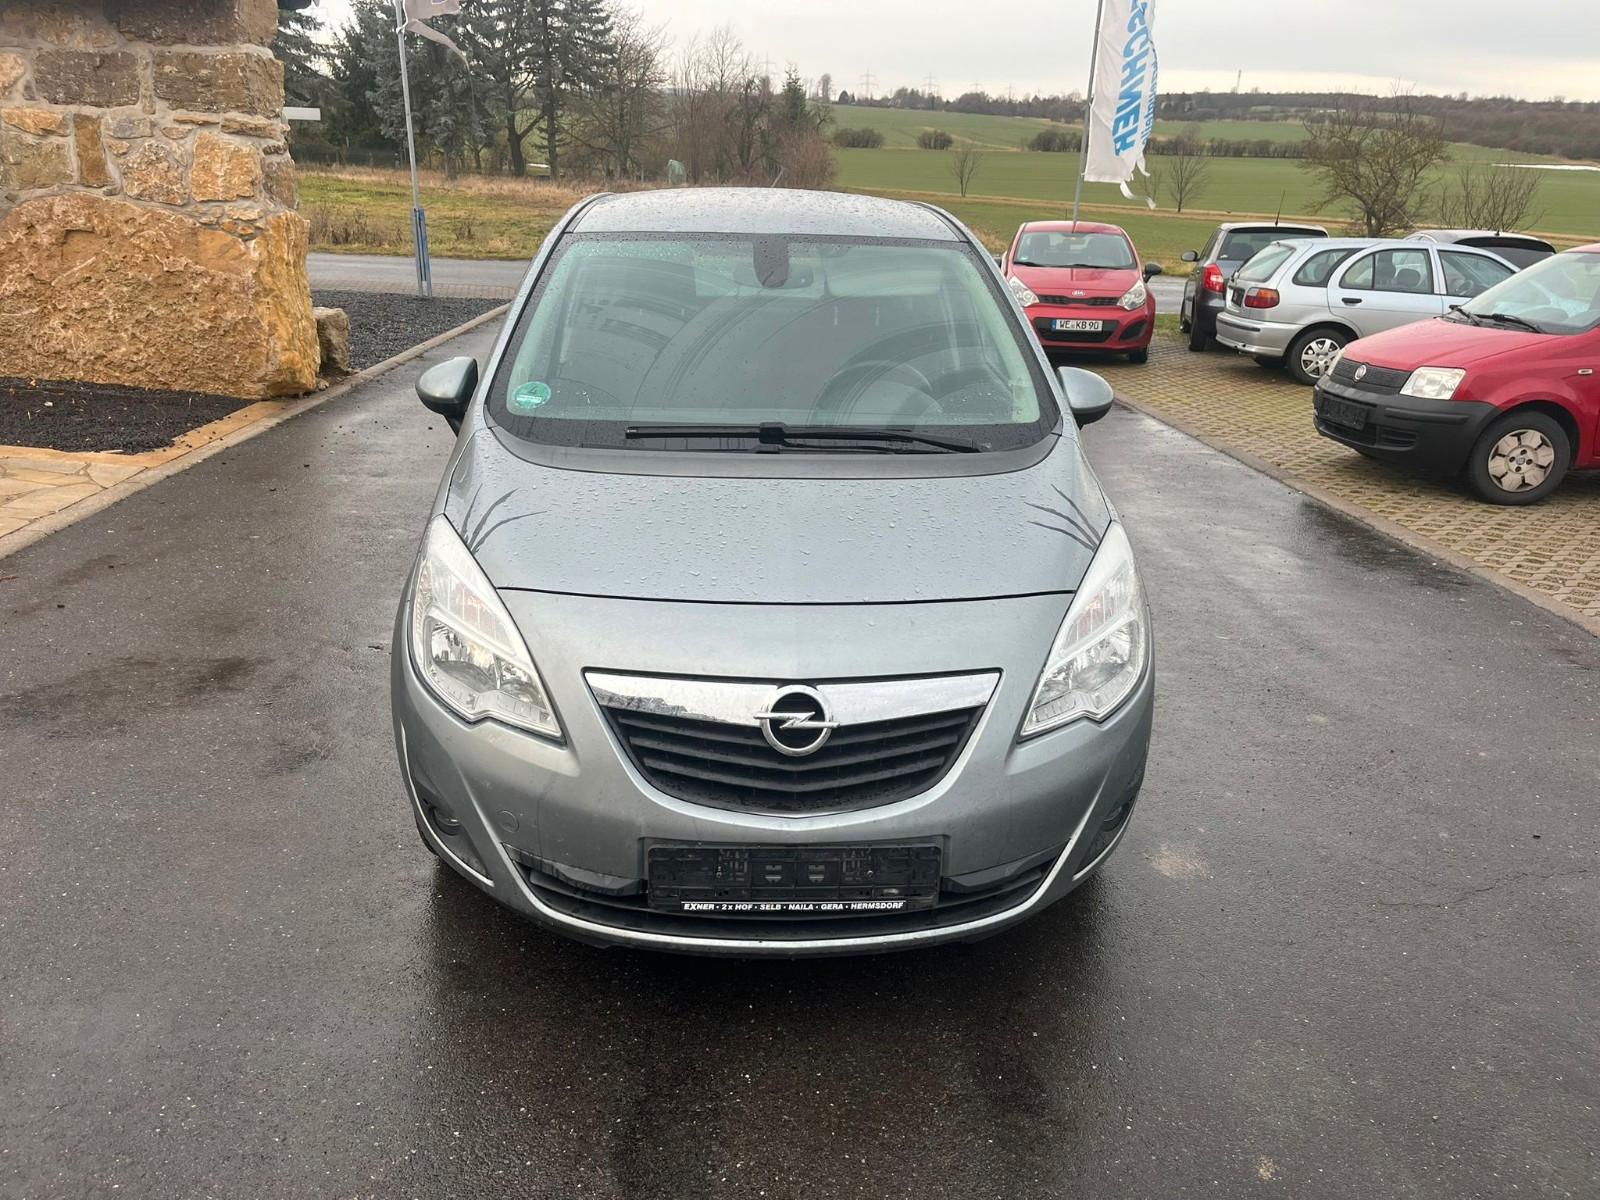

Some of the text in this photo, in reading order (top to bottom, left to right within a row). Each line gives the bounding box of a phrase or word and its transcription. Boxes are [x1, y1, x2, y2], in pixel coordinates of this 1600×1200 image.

[1089, 321, 1099, 330] 90
[684, 903, 714, 911] EXNER
[735, 903, 753, 911] HOF
[760, 903, 781, 911] SELB
[788, 903, 814, 911] NAILA
[850, 902, 904, 910] HERMSDORF
